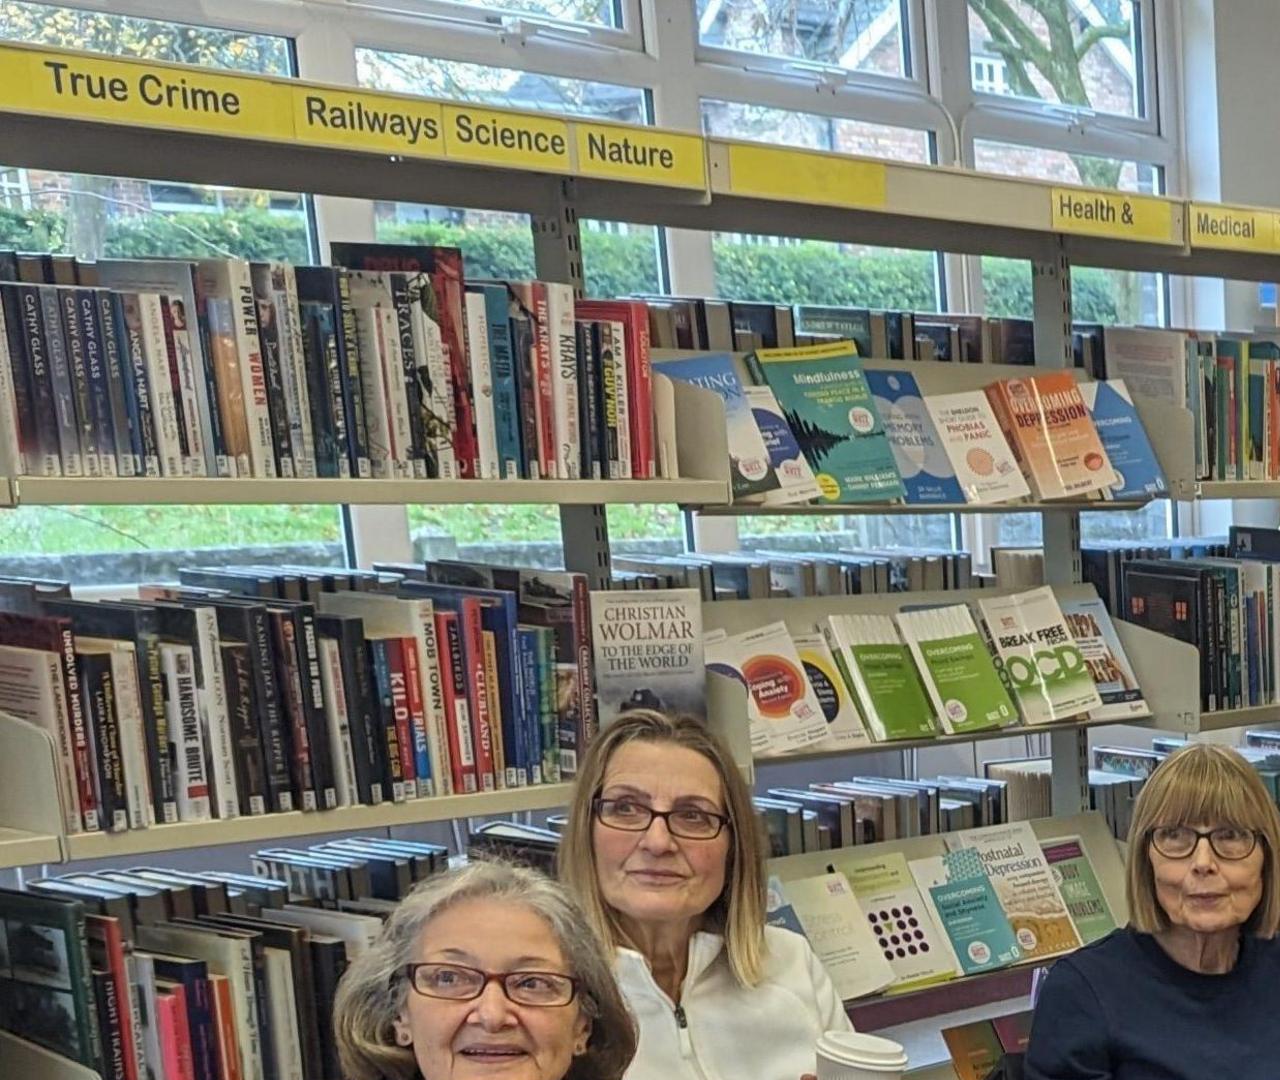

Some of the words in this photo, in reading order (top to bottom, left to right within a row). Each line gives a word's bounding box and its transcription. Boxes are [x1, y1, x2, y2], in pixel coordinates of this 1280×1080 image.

[44, 61, 128, 102] True
[139, 74, 240, 115] Crime
[306, 96, 438, 145] Railways
[456, 114, 565, 155] Science
[588, 132, 674, 168] Nature
[1060, 195, 1115, 223] Health
[1121, 207, 1134, 225] &
[1197, 213, 1255, 239] Medical
[239, 285, 256, 336] POWER
[559, 333, 577, 381] KRAYS
[247, 352, 266, 406] WOMEN
[793, 369, 861, 386] Mindfulness
[884, 421, 924, 434] MEMORY
[946, 421, 986, 433] PHOBIAS
[600, 620, 695, 641] WOLMAR
[604, 605, 686, 621] CHRISTIAN
[423, 621, 435, 656] MOB
[601, 646, 617, 658] TO
[618, 645, 638, 658] THE
[641, 644, 674, 657] EDGE
[677, 643, 694, 656] OF
[998, 630, 1034, 649] BREAK
[1036, 624, 1066, 641] FREE
[1046, 634, 1068, 646] FROM
[608, 657, 633, 671] THE
[634, 656, 689, 670] WORLD
[1004, 645, 1088, 687] OCD
[62, 629, 78, 690] UNSOLVED
[70, 693, 86, 748] MURDERS
[390, 671, 409, 721] KILO
[428, 659, 442, 711] TOWN
[176, 676, 199, 743] HANDSOME
[412, 711, 426, 753] TRIALS
[184, 745, 203, 783] BRUTE
[985, 858, 1042, 878] Depression
[937, 886, 986, 902] OVERCOMING
[106, 980, 118, 1027] NIGHT
